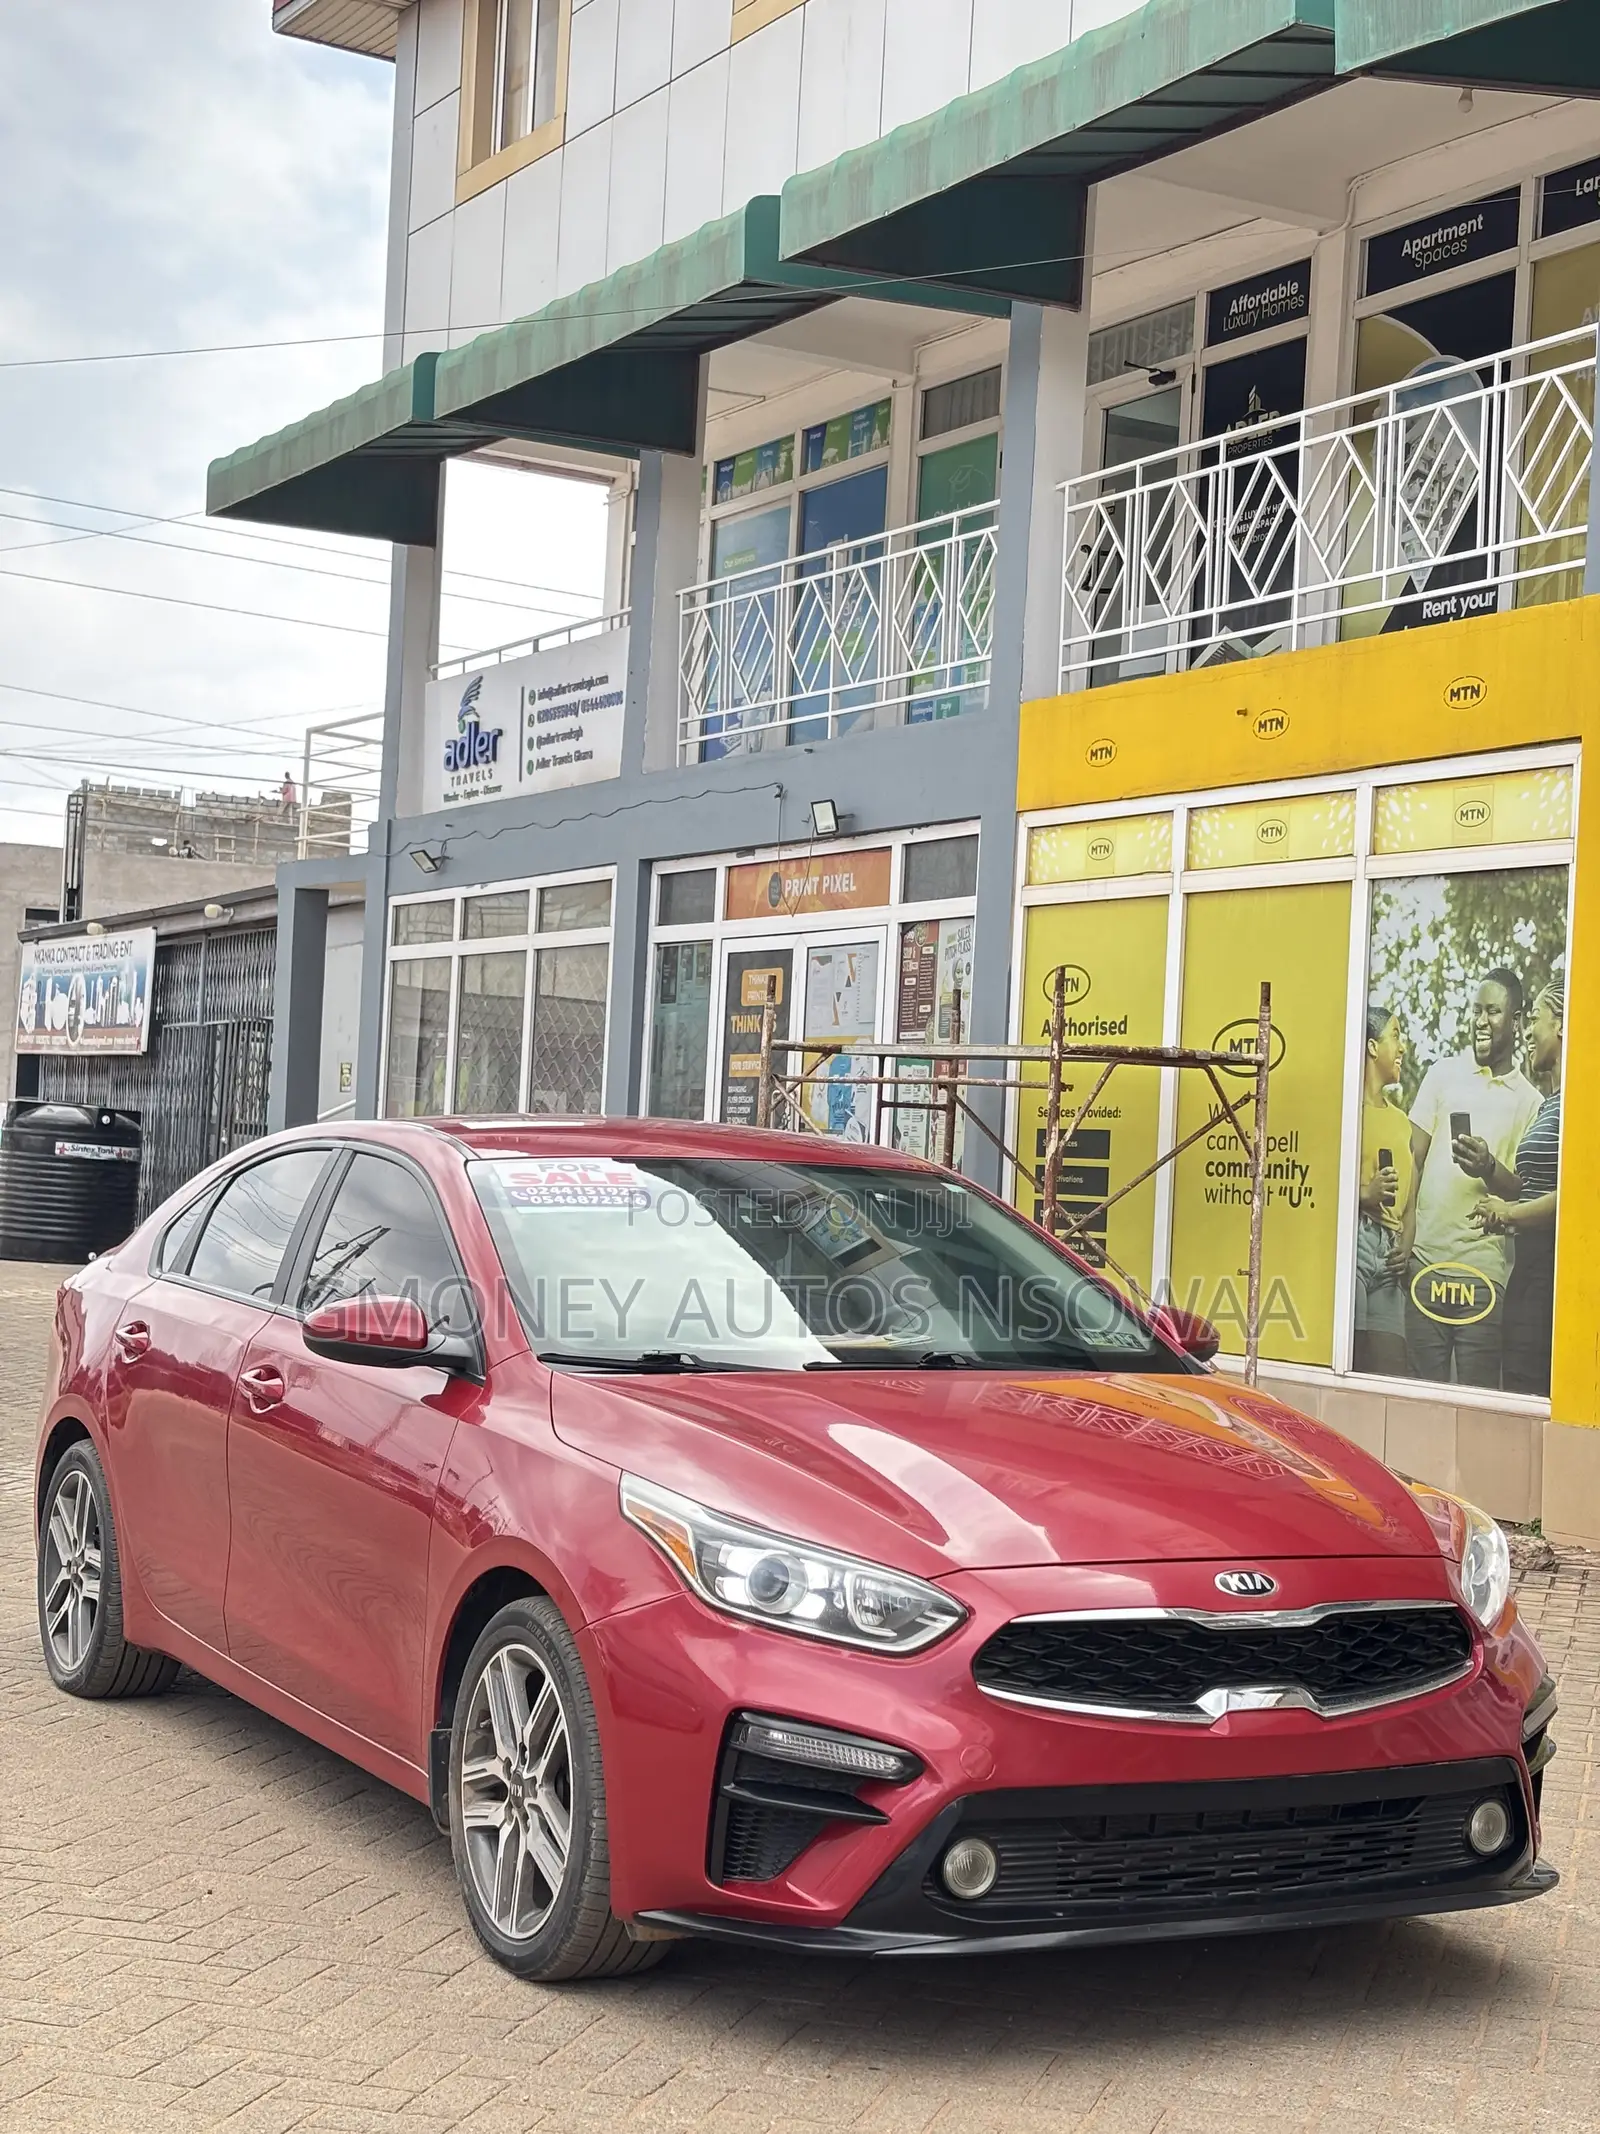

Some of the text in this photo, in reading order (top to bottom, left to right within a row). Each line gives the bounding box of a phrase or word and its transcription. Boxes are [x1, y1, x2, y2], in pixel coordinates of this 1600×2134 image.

[1401, 213, 1484, 259] Apartment
[1229, 280, 1299, 315] Affordable
[1223, 294, 1305, 332] Luxury Homes
[1227, 435, 1273, 456] PROPERTIES
[1422, 590, 1496, 619] Rent your
[1450, 684, 1481, 703] MTN
[1258, 716, 1286, 733] MTN
[443, 720, 503, 772] adler
[1089, 744, 1114, 762] MTN
[451, 768, 493, 787] TRAVELS
[1461, 805, 1486, 822] MTN
[1261, 825, 1285, 839] MTN
[1091, 842, 1110, 857] MTN
[784, 876, 820, 898] PRINT
[822, 872, 857, 894] PIXEL
[731, 1014, 762, 1033] THINK
[1266, 1131, 1299, 1158] pell
[537, 1163, 605, 1173] FOR
[509, 1172, 637, 1185] SALE
[1204, 1182, 1274, 1206] withot
[1430, 1281, 1477, 1307] MTN
[1222, 1573, 1273, 1592] KIA
